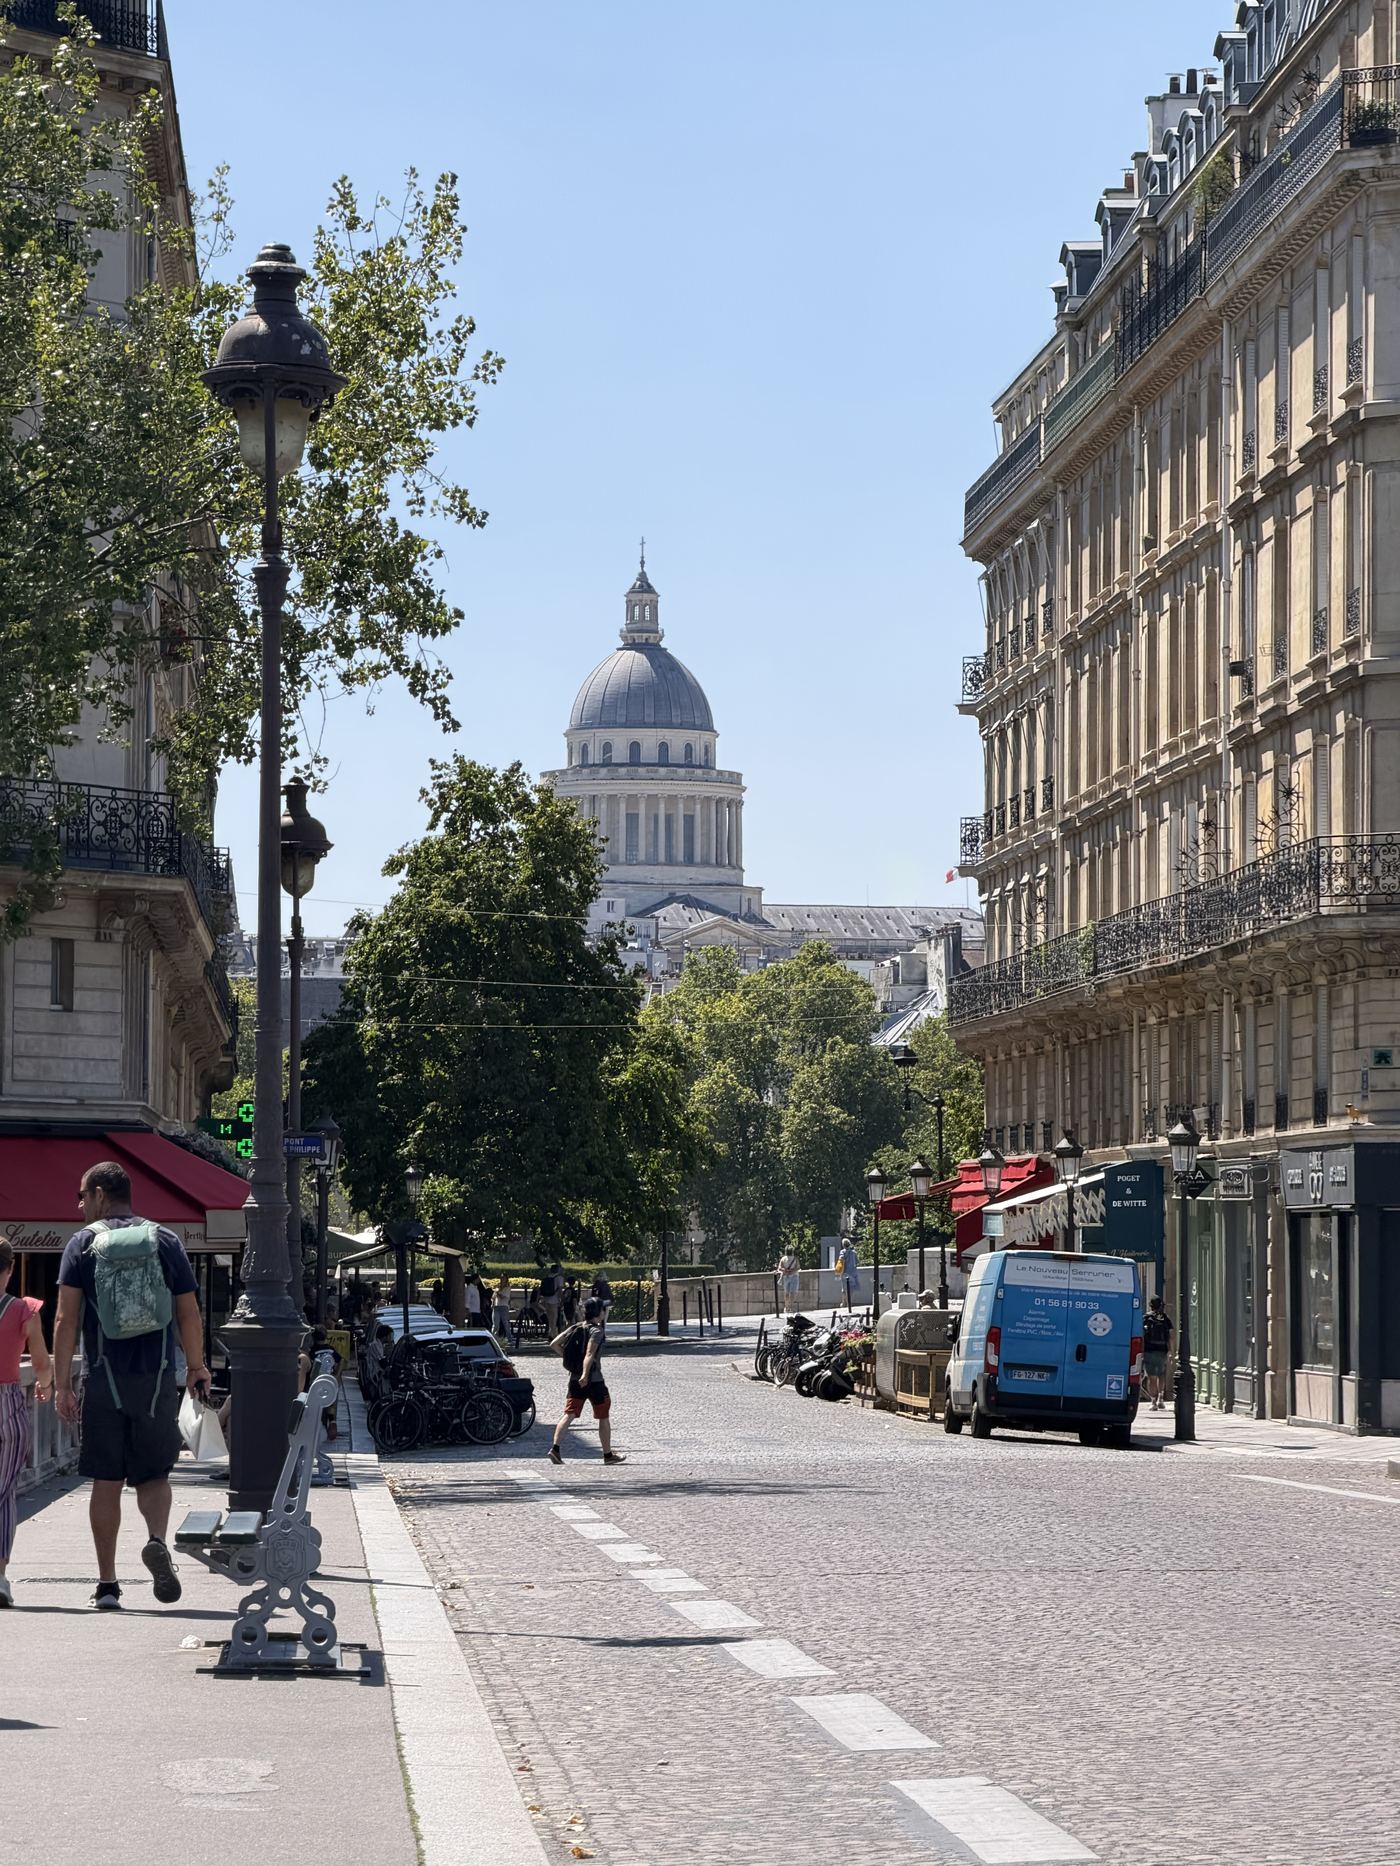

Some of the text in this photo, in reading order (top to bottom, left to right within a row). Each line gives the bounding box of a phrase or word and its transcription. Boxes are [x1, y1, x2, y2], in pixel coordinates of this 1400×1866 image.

[289, 1145, 321, 1153] PHILIPPE
[5, 1224, 62, 1247] Lutetia
[1028, 1266, 1069, 1275] Nouveau
[1034, 1298, 1046, 1306] 01
[1075, 1301, 1087, 1309] 90
[1087, 1302, 1100, 1310] 33
